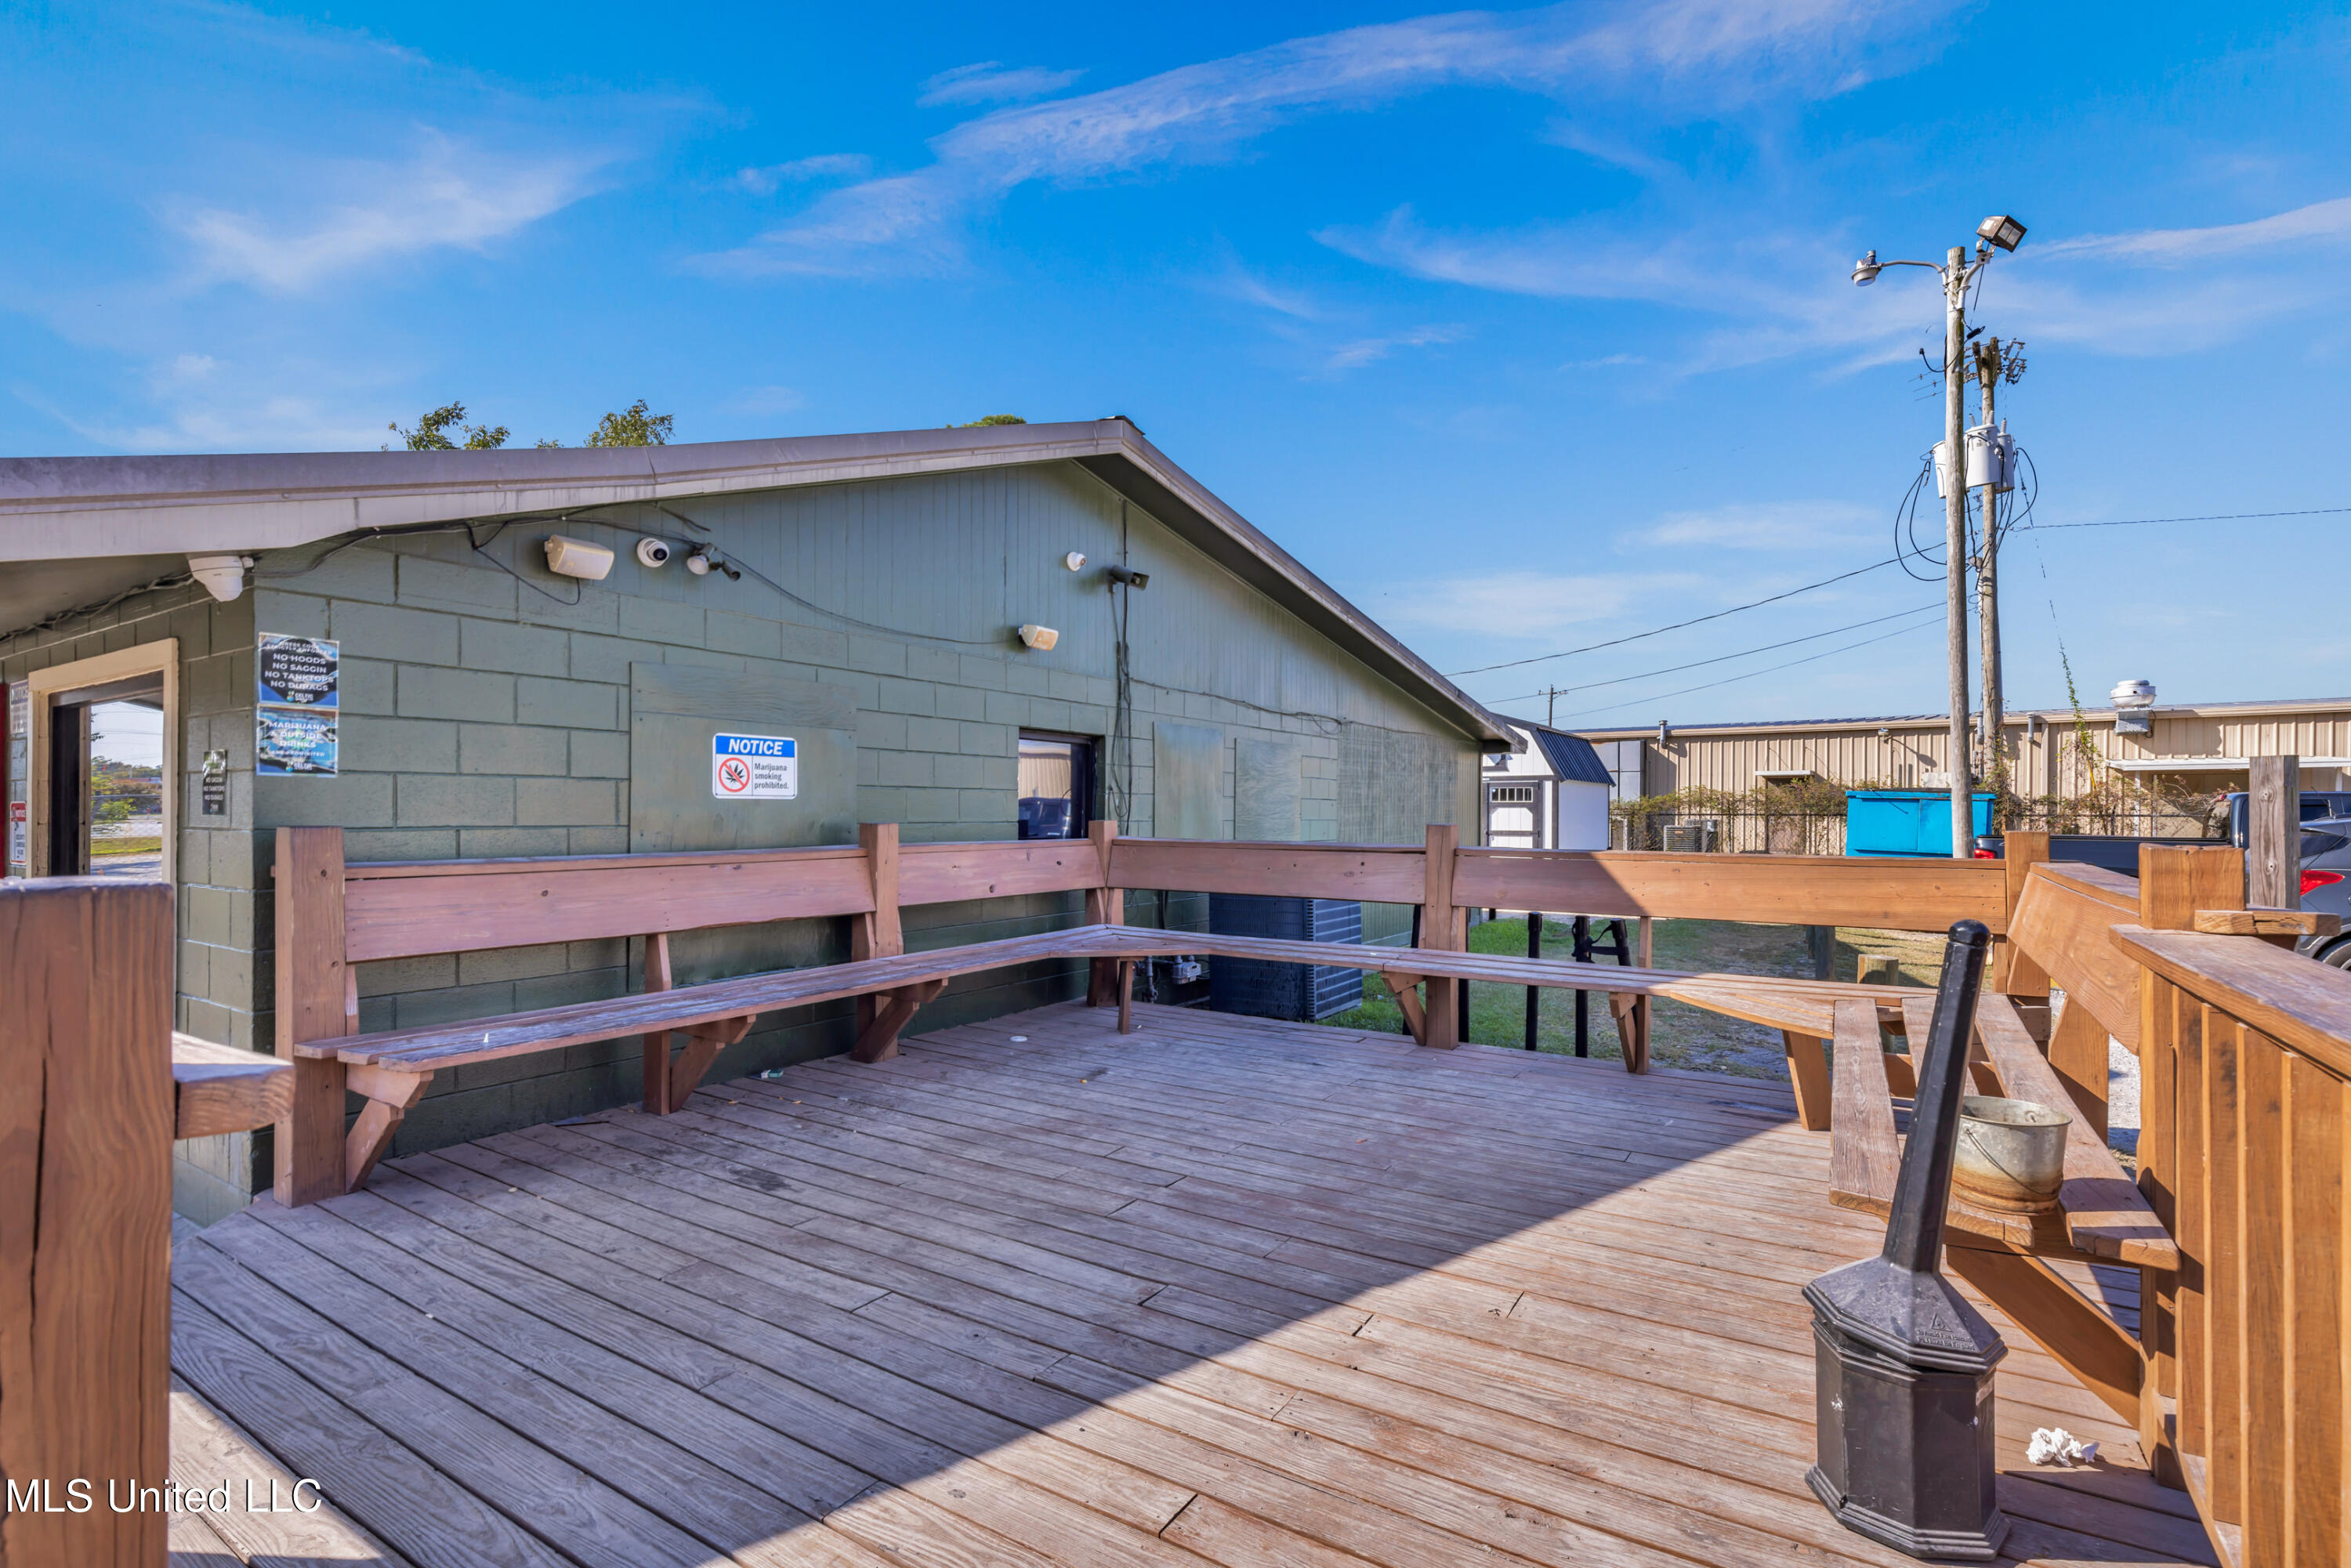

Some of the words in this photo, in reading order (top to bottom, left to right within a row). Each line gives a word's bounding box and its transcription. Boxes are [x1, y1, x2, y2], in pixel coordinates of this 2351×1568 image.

[291, 654, 327, 664] HOODS
[282, 672, 334, 683] TANKTOPS
[288, 682, 329, 691] DURAGS
[268, 722, 327, 730] MARIJUANA
[280, 731, 322, 740] OUTSIDE
[728, 738, 784, 755] NOTICE
[754, 763, 788, 772] Marijuana
[754, 773, 782, 782] smoking
